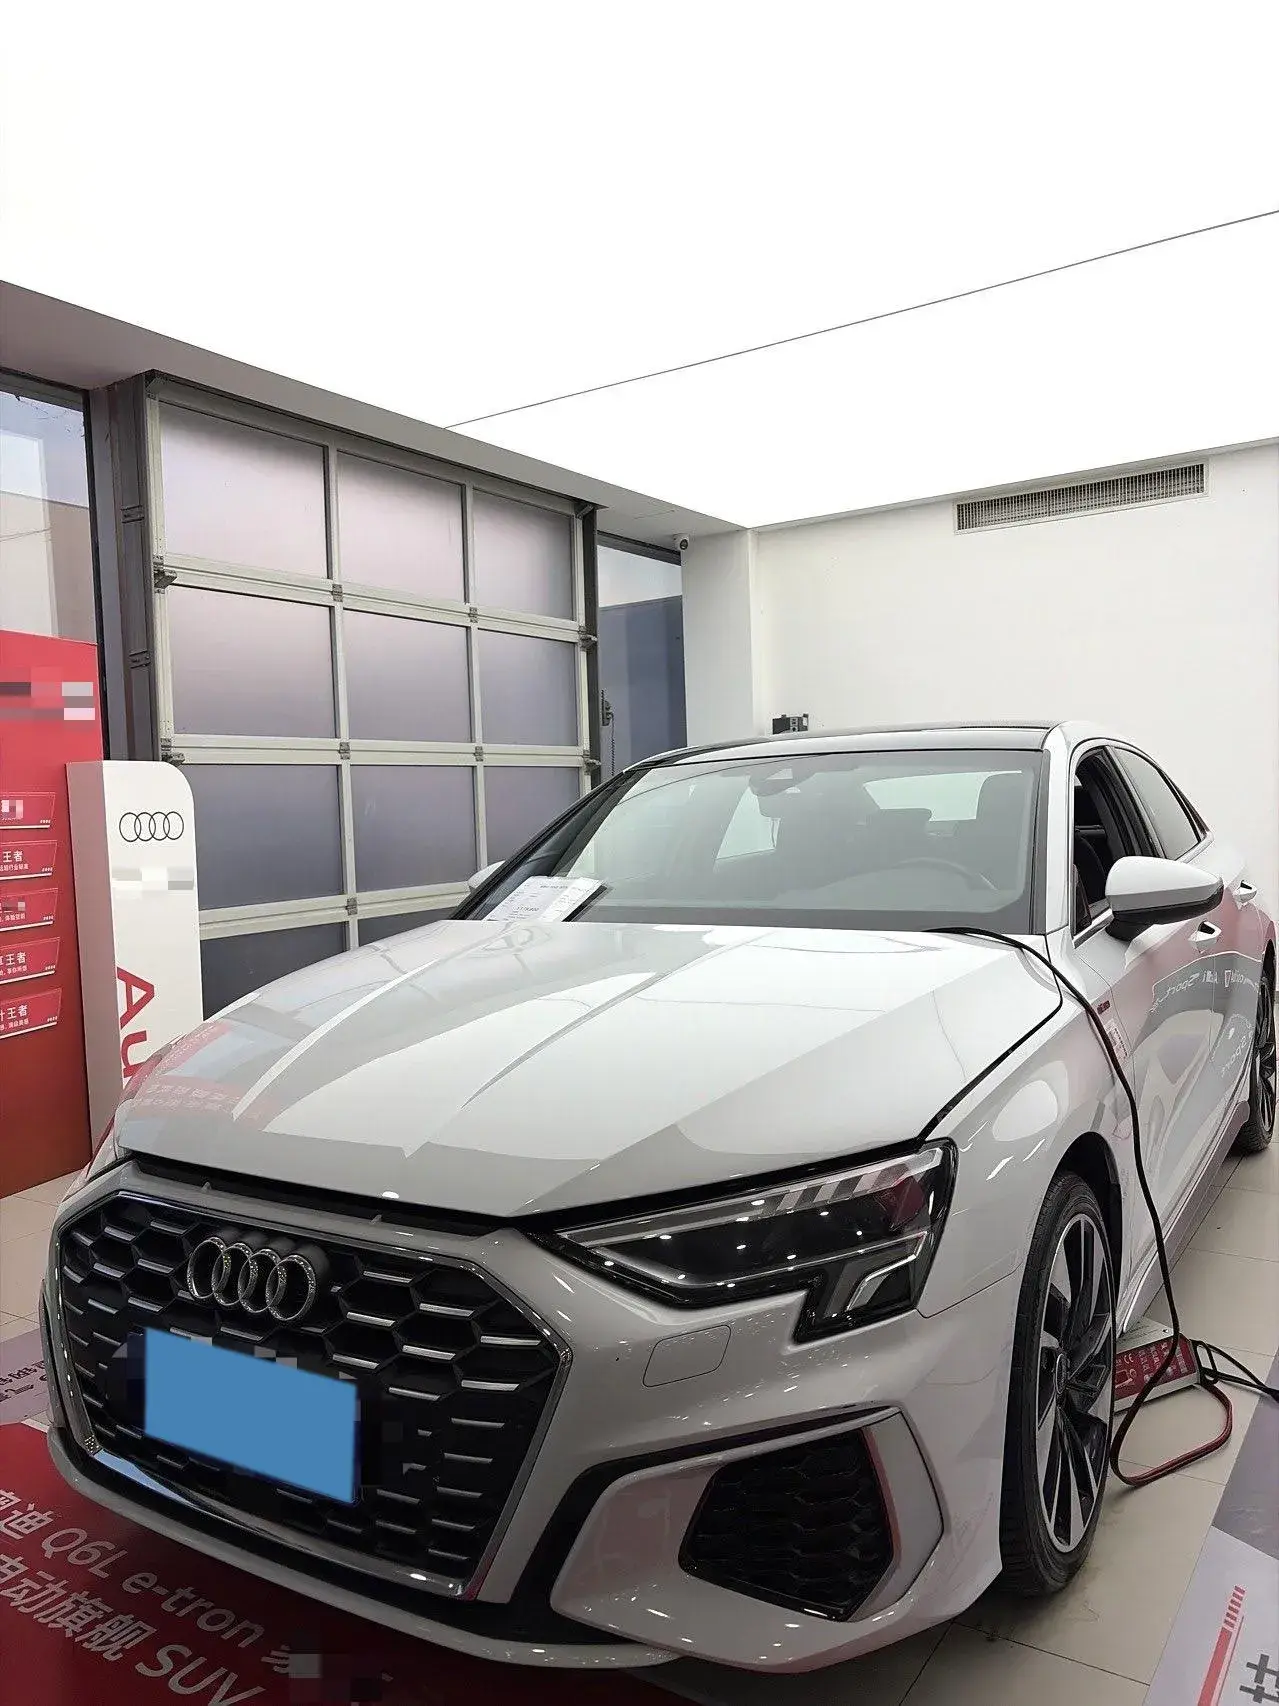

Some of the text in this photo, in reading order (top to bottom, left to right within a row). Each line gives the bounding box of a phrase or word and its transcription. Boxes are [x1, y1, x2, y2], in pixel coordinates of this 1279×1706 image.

[3, 850, 23, 863] 王者
[41, 1528, 129, 1579] Q6L
[121, 1572, 266, 1648] e-tron
[135, 1644, 266, 1706] SUV
